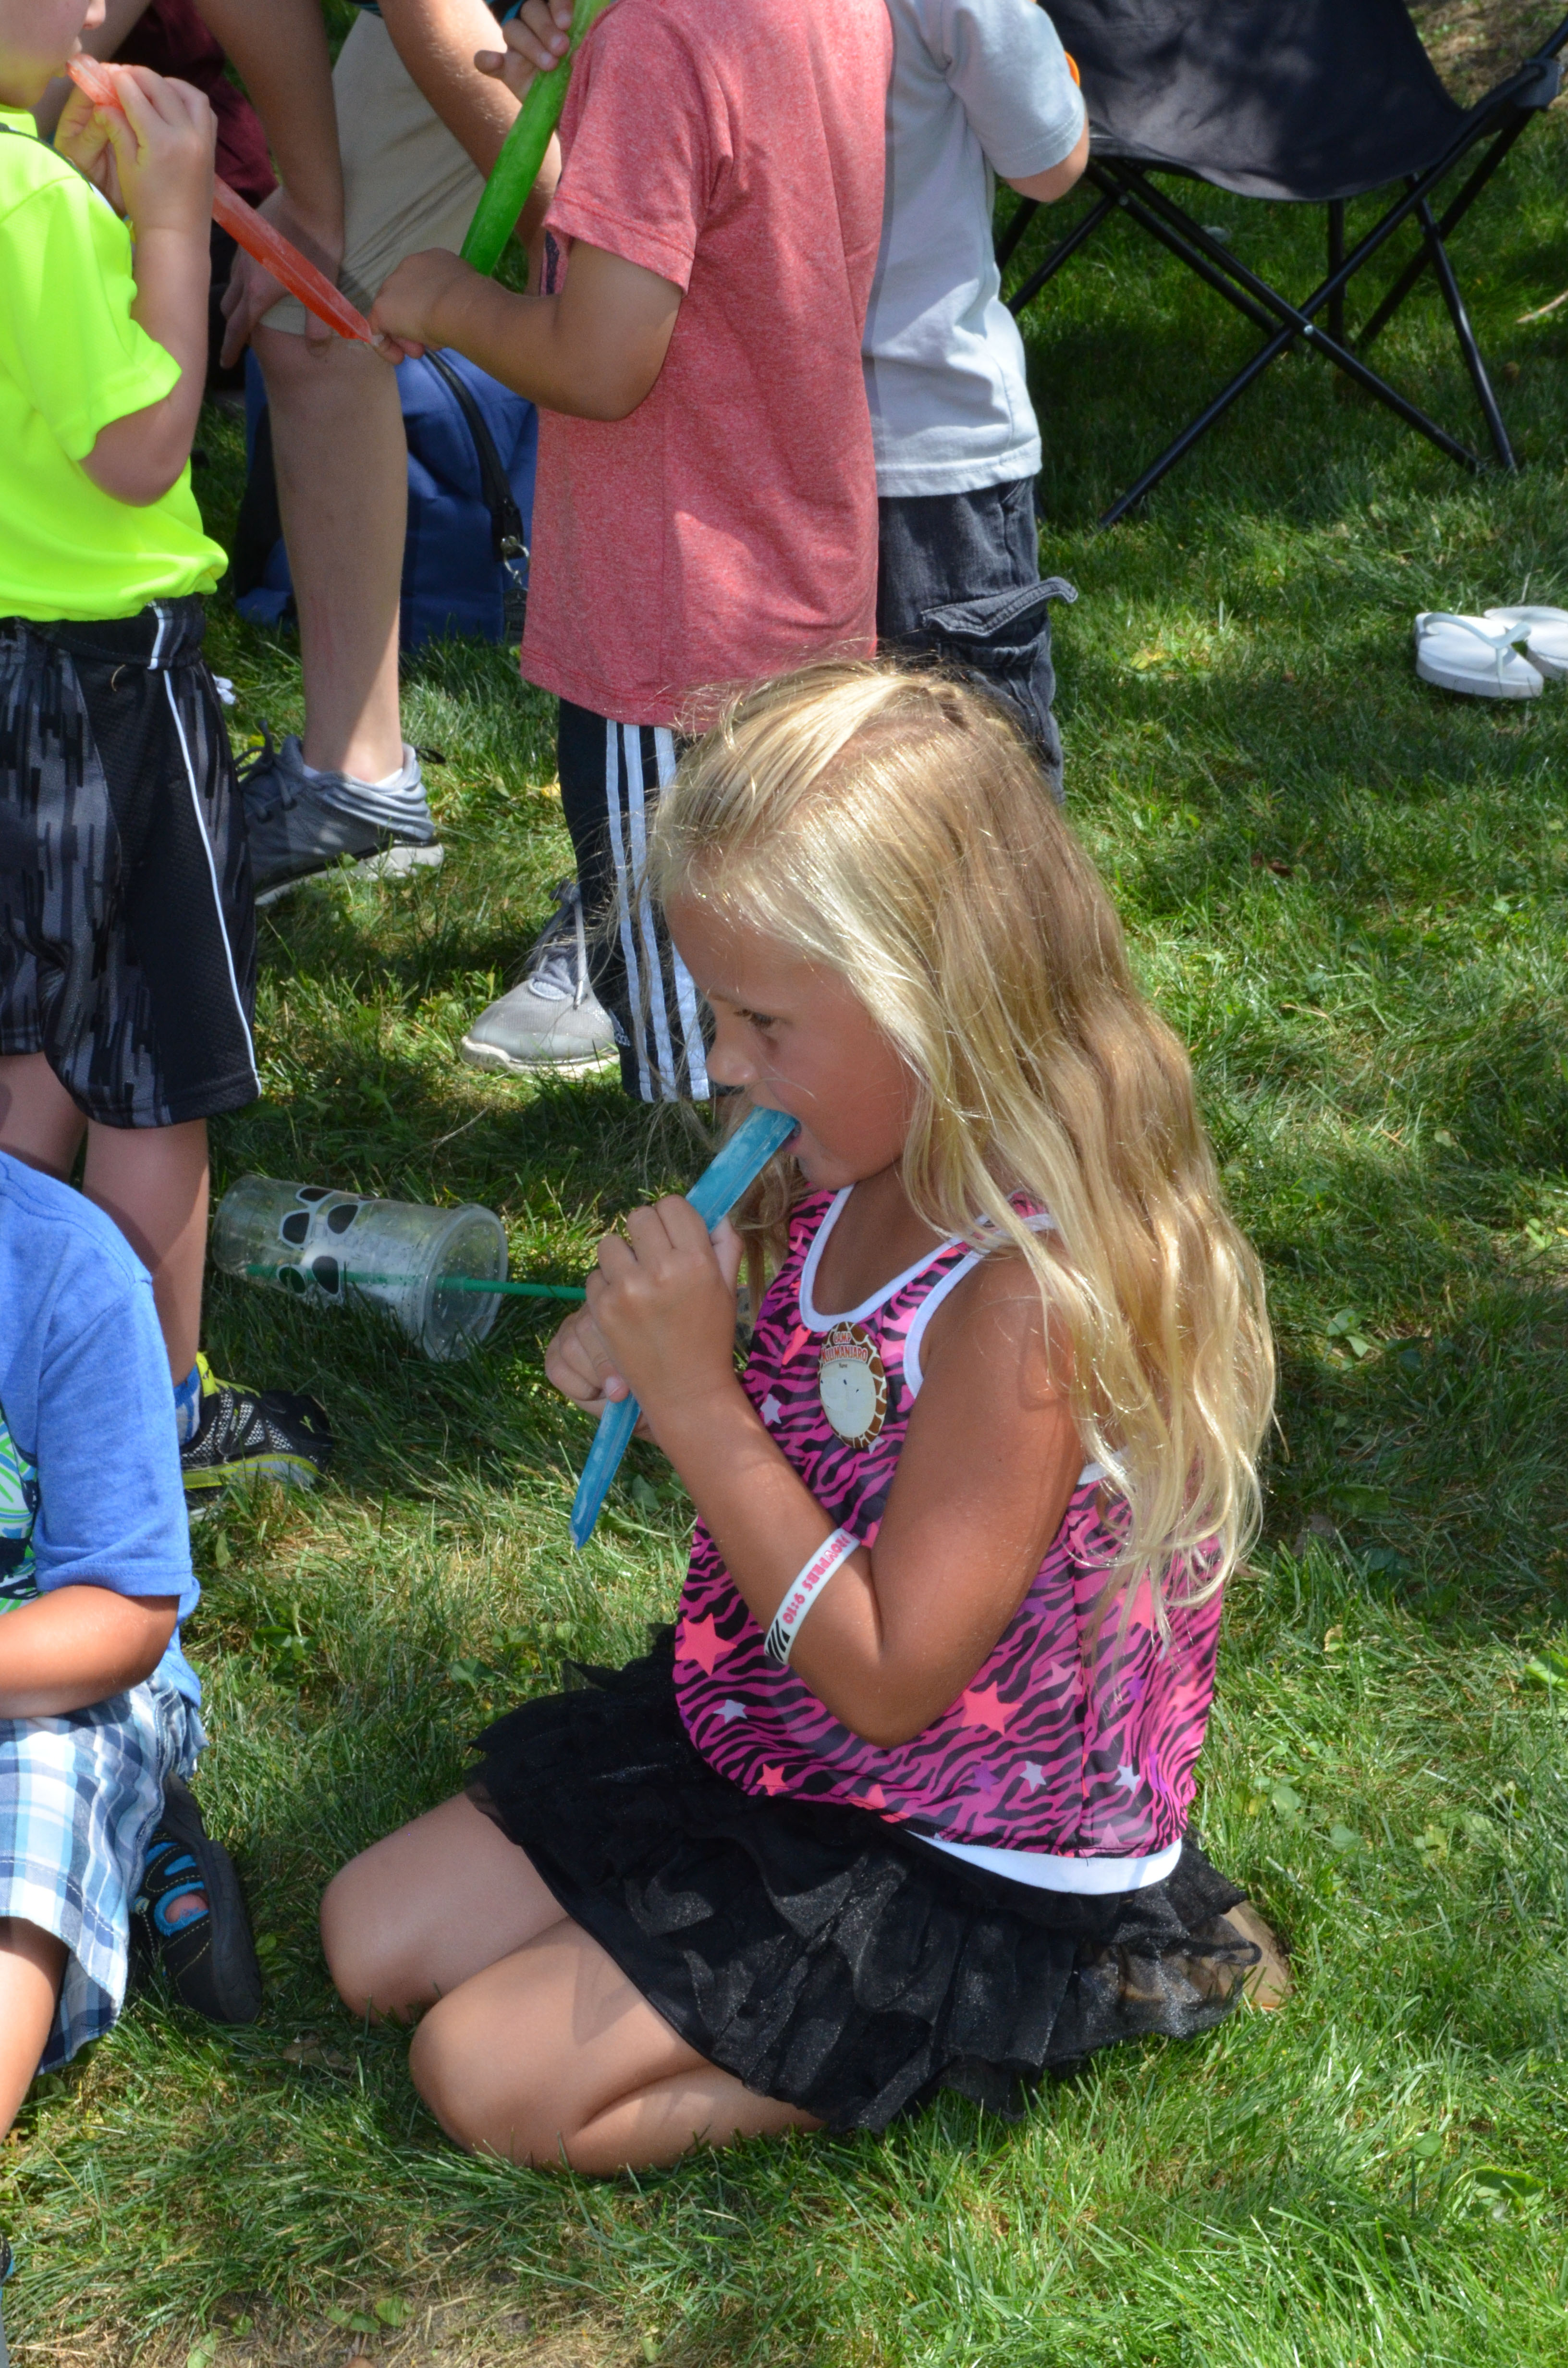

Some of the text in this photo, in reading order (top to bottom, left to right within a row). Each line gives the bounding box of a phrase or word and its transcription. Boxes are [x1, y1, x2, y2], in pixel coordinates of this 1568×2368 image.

[833, 1331, 852, 1344] CAMP
[821, 1345, 868, 1365] KILIMANJARO
[782, 1592, 806, 1625] 9:10
